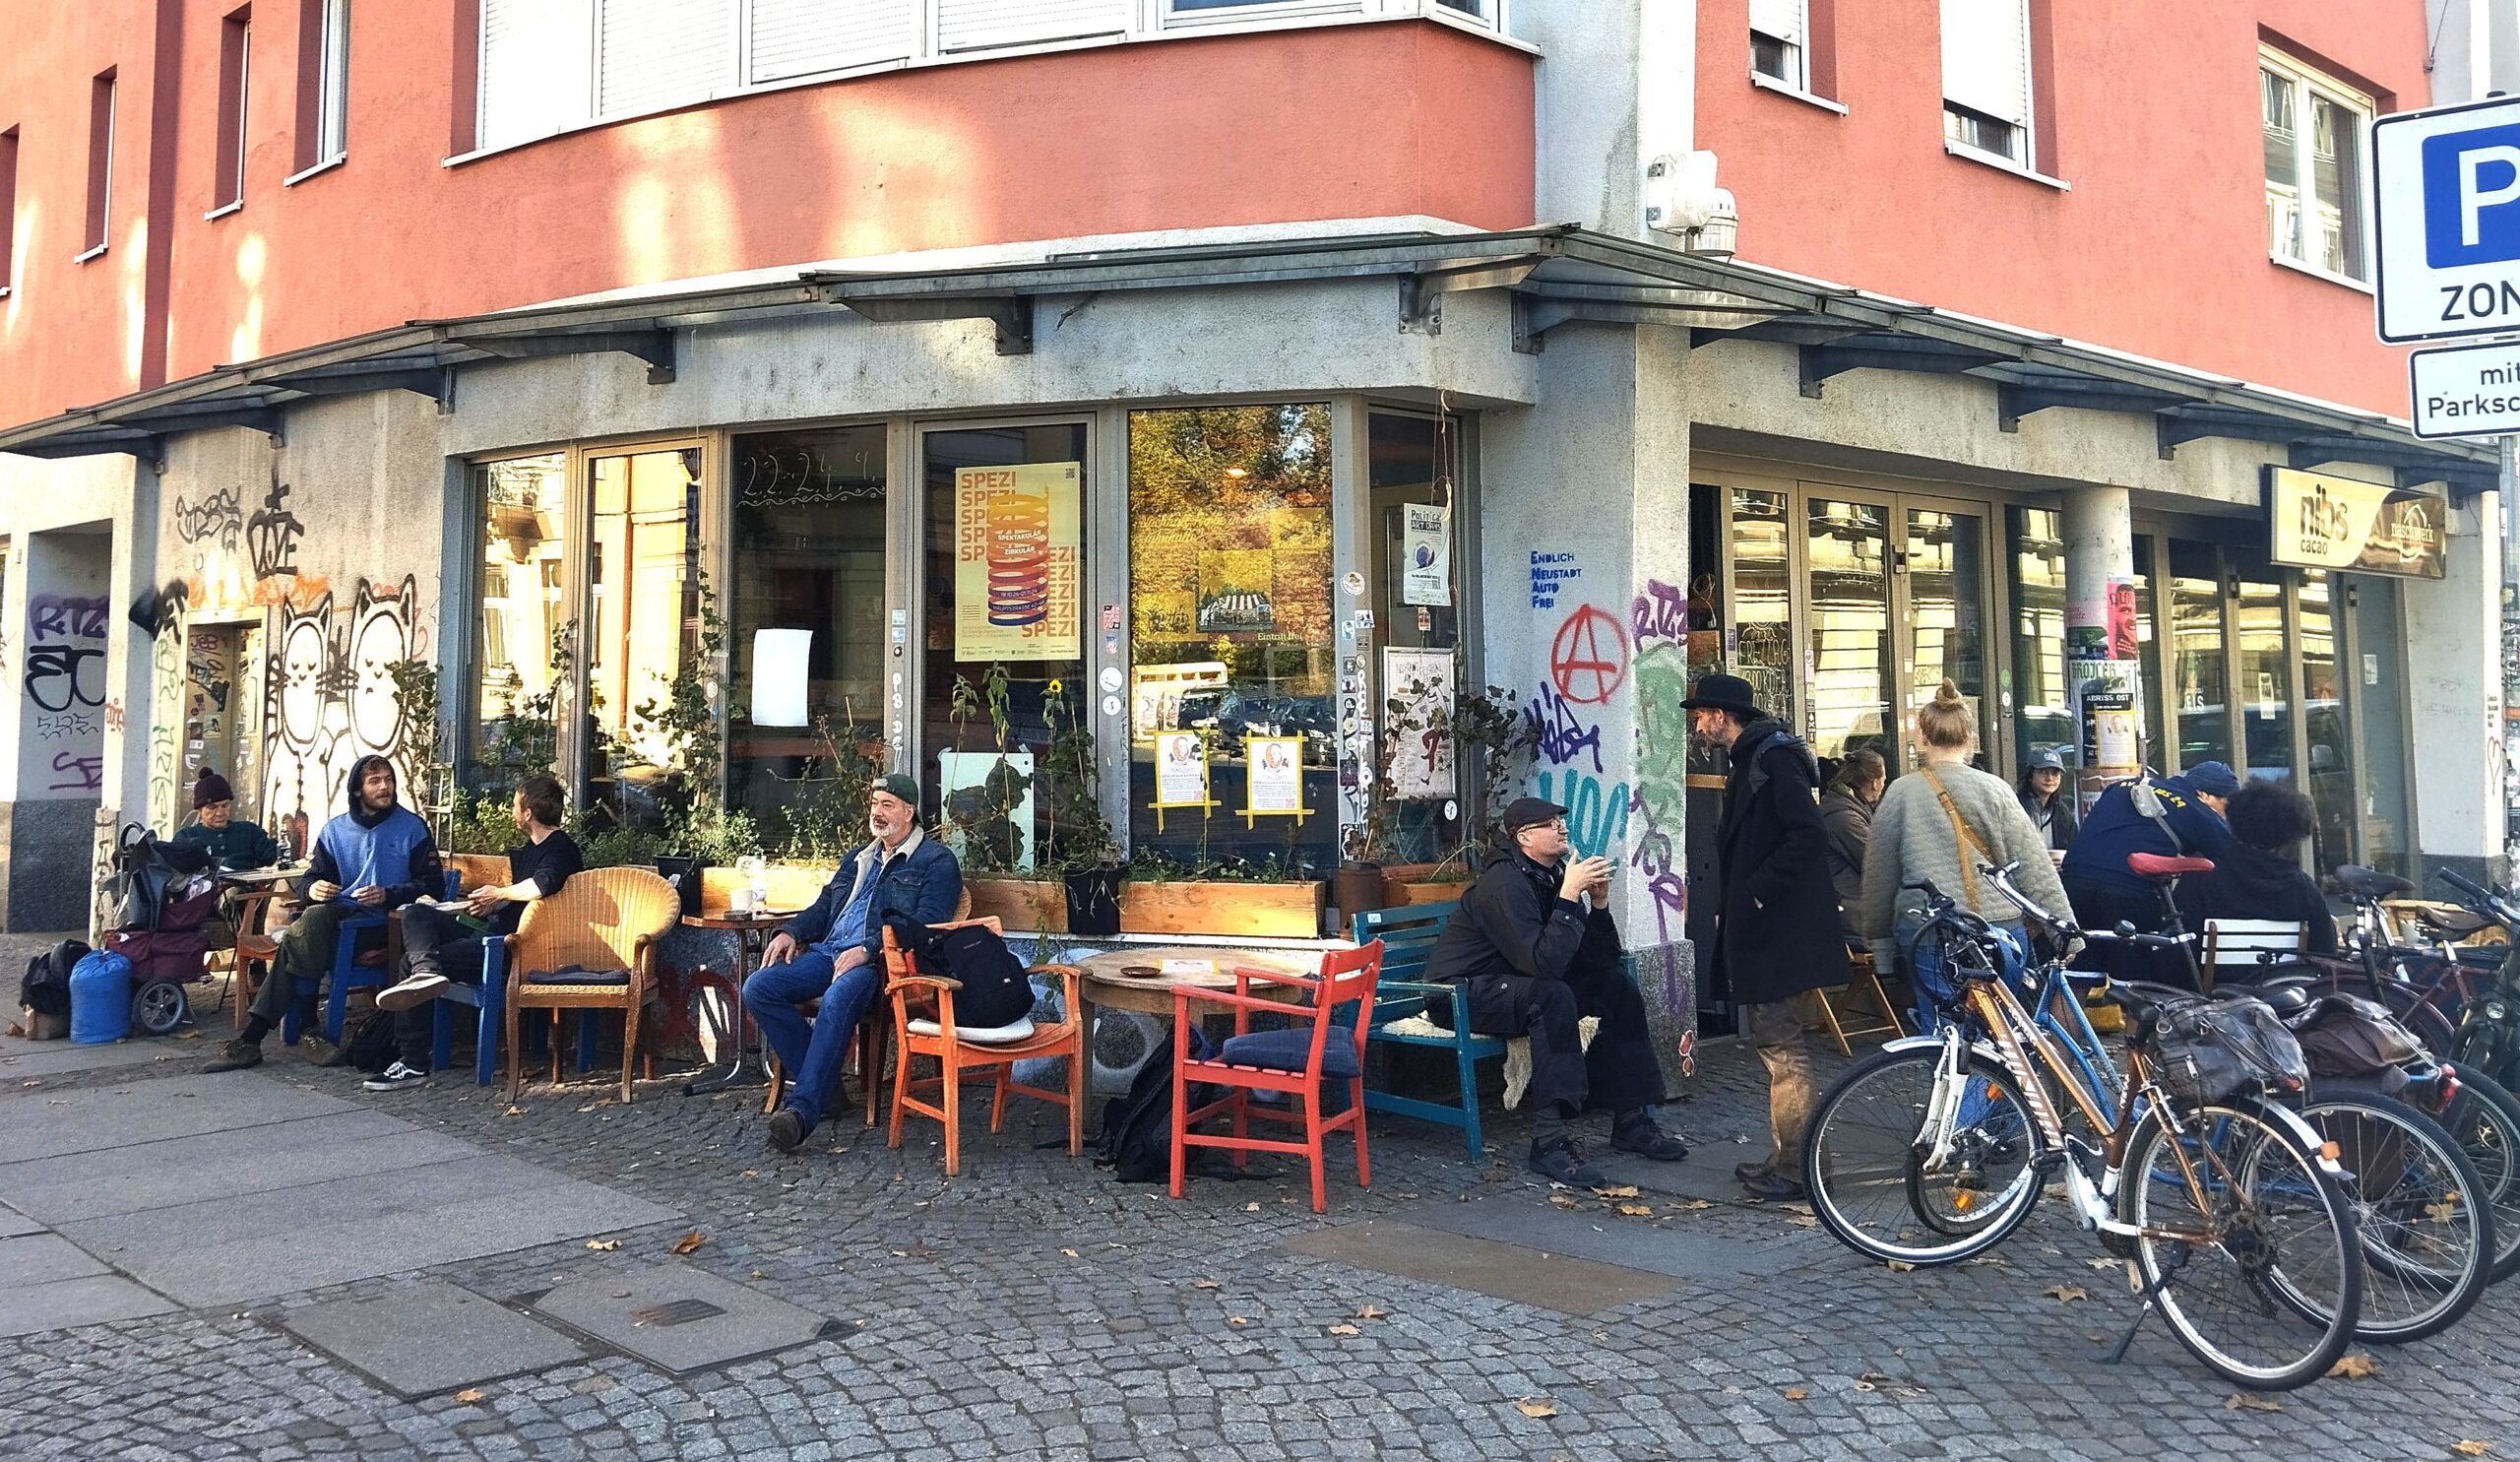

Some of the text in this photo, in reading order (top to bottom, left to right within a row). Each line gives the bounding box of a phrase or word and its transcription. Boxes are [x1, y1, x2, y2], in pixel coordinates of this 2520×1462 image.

[2459, 145, 2520, 246] P
[961, 471, 1016, 489] SPEZI
[2300, 483, 2349, 541] nibs
[2391, 522, 2434, 543] naschwerk
[2300, 539, 2328, 555] cacao
[1022, 620, 1076, 638] SPEZI
